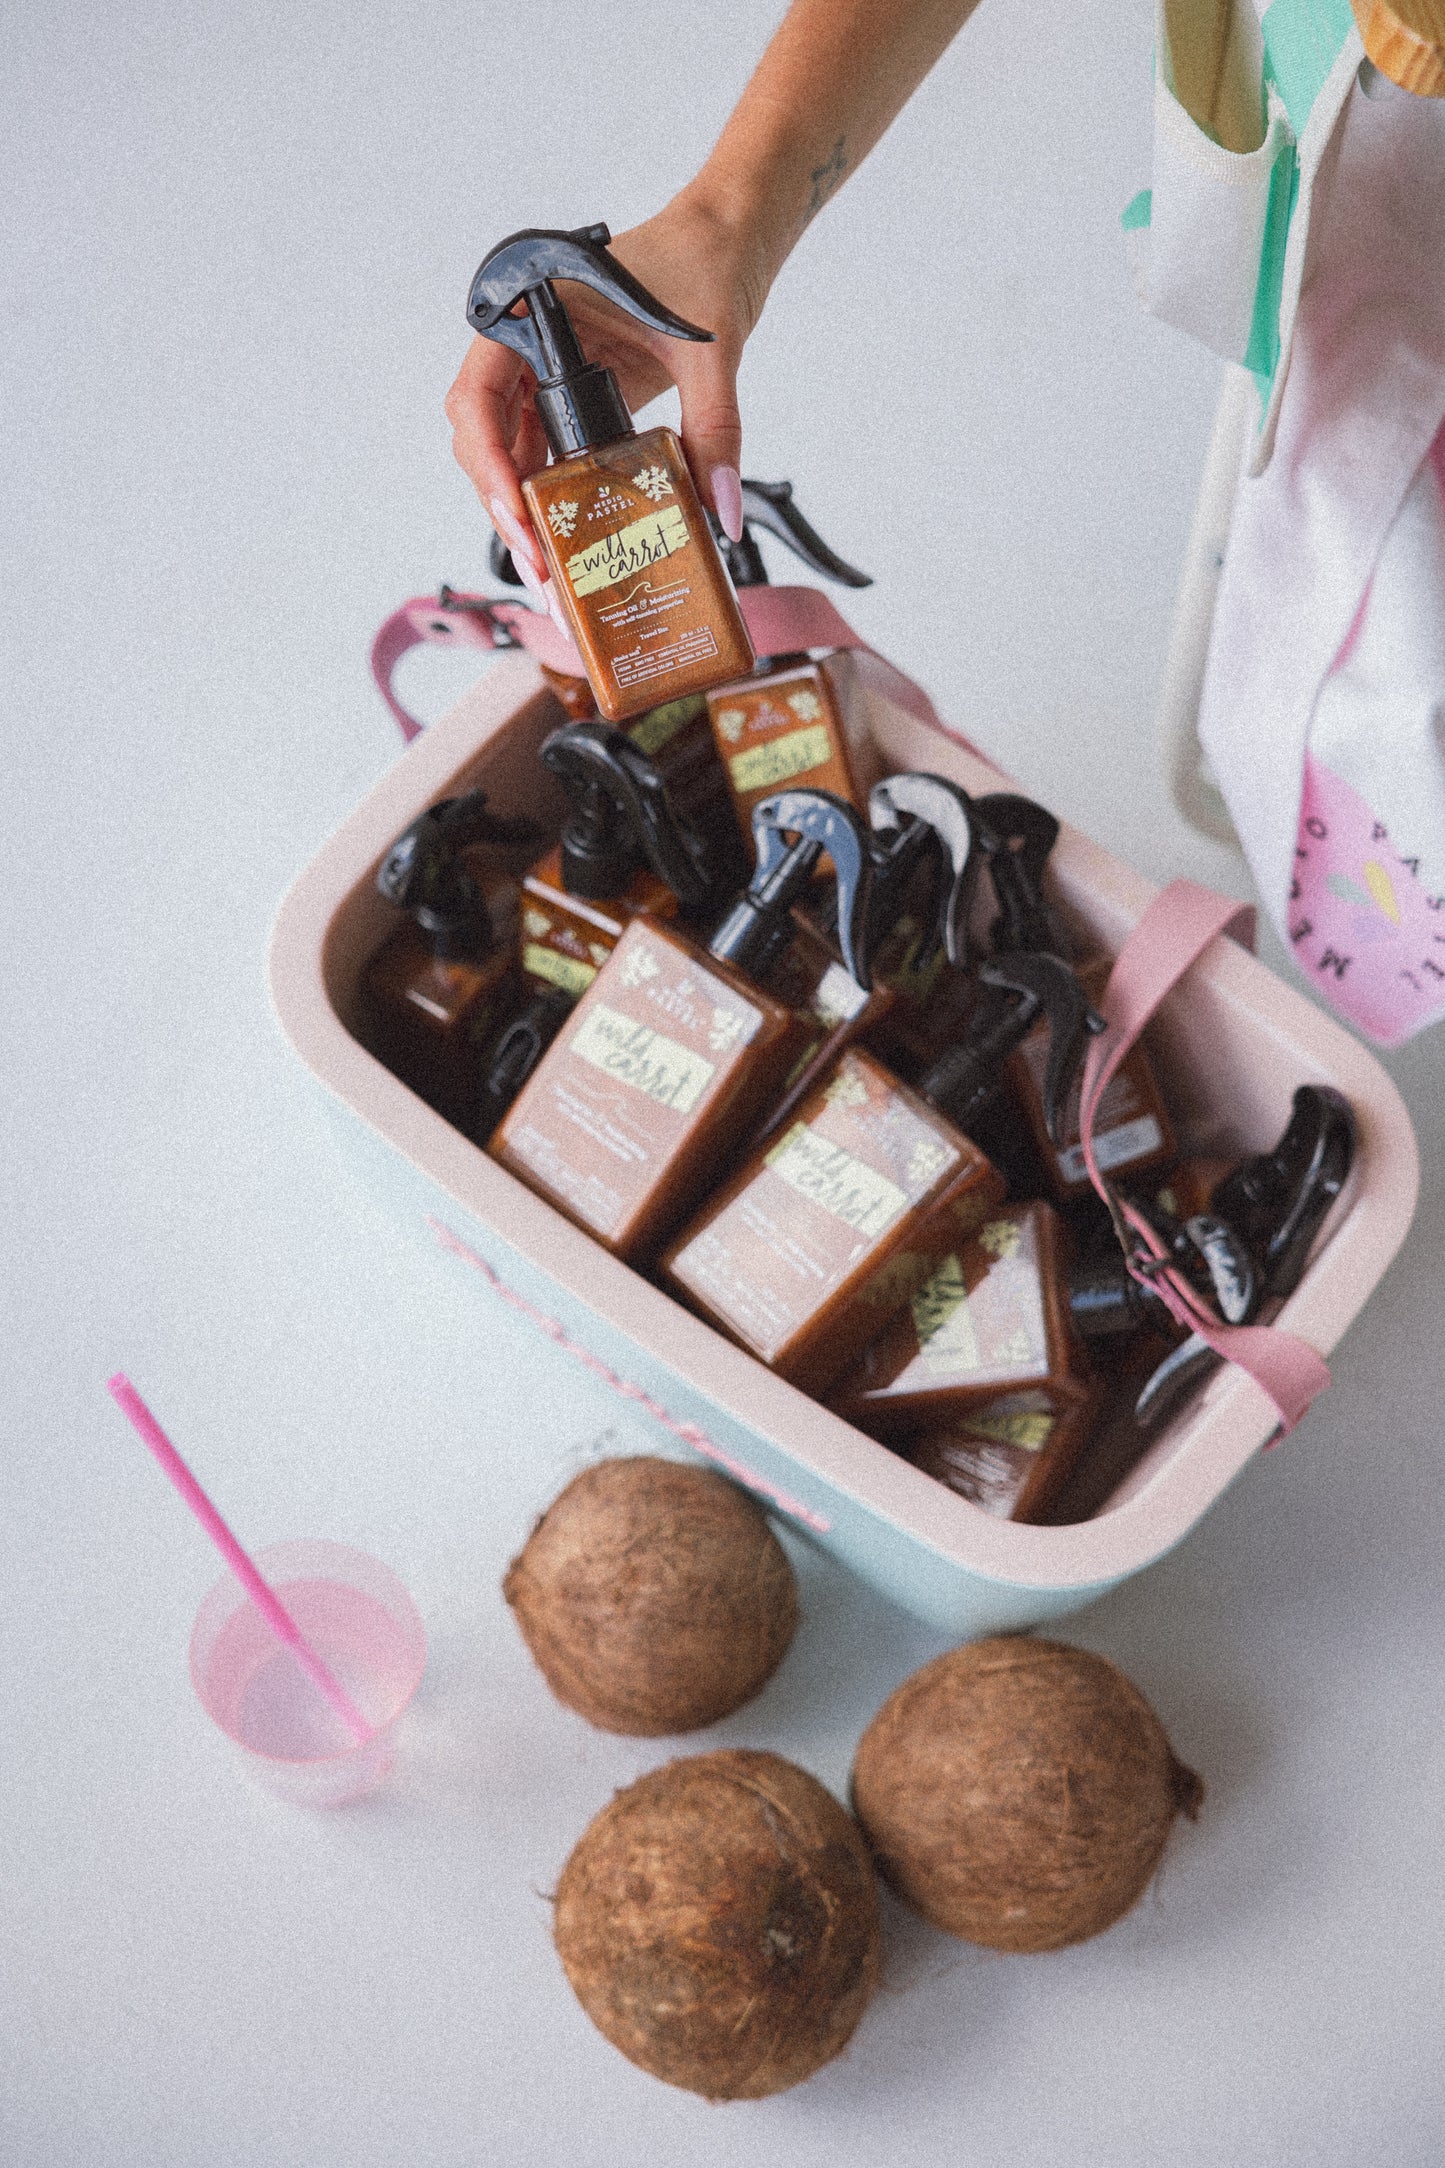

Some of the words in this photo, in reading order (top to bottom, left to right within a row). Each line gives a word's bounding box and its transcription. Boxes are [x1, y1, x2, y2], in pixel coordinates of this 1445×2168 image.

[587, 498, 635, 521] PASTEL
[594, 495, 622, 510] MEDIO
[583, 531, 627, 572] wild
[609, 524, 671, 579] carrot
[599, 610, 628, 623] Tanning
[627, 604, 639, 613] Oil
[612, 619, 626, 628] with
[640, 629, 658, 640] Travel
